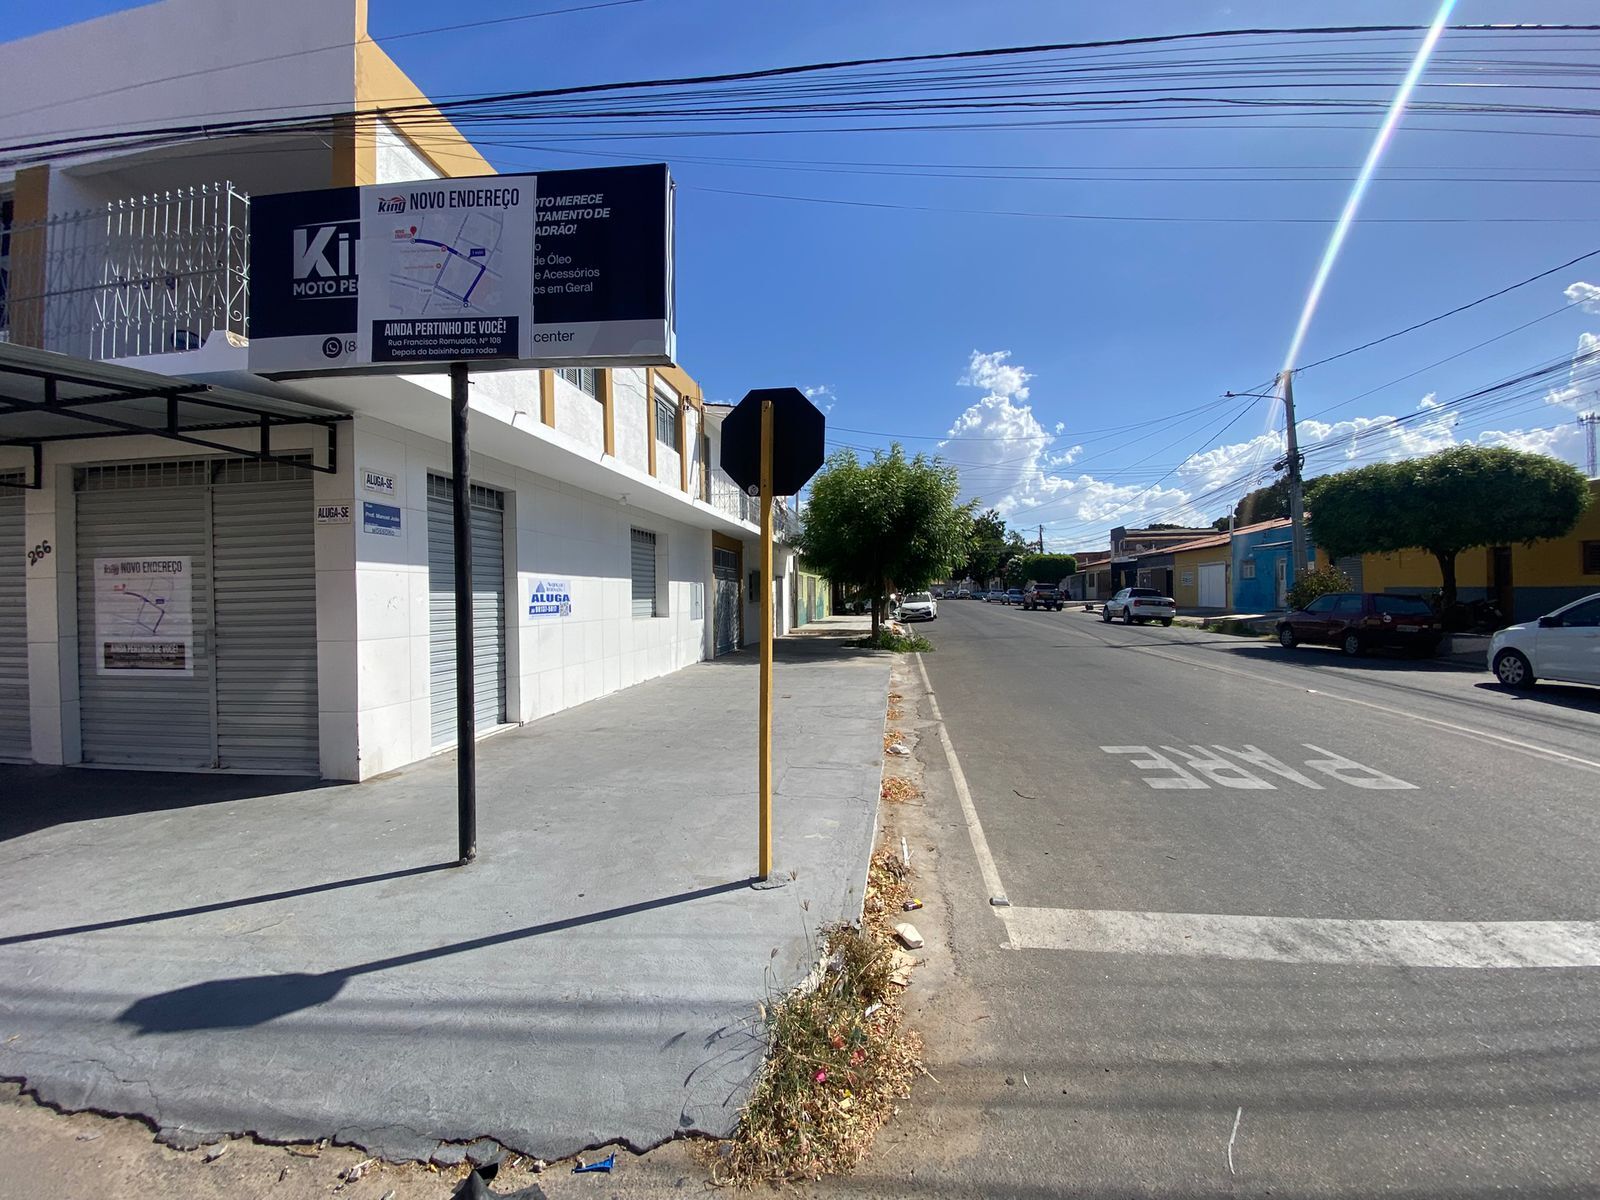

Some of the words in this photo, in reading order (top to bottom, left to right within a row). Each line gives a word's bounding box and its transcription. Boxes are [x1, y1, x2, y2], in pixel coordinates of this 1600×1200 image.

[410, 191, 445, 210] NOVO
[450, 188, 520, 209] ENDEREÇO
[555, 193, 604, 207] MERECE
[594, 207, 611, 218] DE
[547, 251, 572, 265] Óleo
[534, 272, 542, 280] e
[543, 267, 600, 279] Acessórios
[293, 280, 337, 296] MOTO
[339, 279, 358, 293] PE
[547, 285, 563, 294] em
[565, 281, 593, 293] Geral
[384, 322, 413, 337] AINDA
[415, 320, 462, 336] PERTINHO
[464, 320, 477, 334] DE
[479, 317, 507, 334] VOCÊ!
[403, 338, 438, 346] Francisco
[489, 336, 502, 344] 108
[533, 330, 575, 343] center
[391, 349, 416, 357] Depois
[460, 347, 474, 355] das
[475, 346, 497, 354] rodas
[366, 473, 393, 490] ALUGA-SE
[317, 506, 349, 518] ALUGA-SE
[27, 539, 52, 567] 266
[120, 562, 141, 574] NOVO
[142, 560, 183, 575] ENDEREÇO
[531, 593, 571, 603] ALUGA
[1099, 743, 1421, 790] PARE
